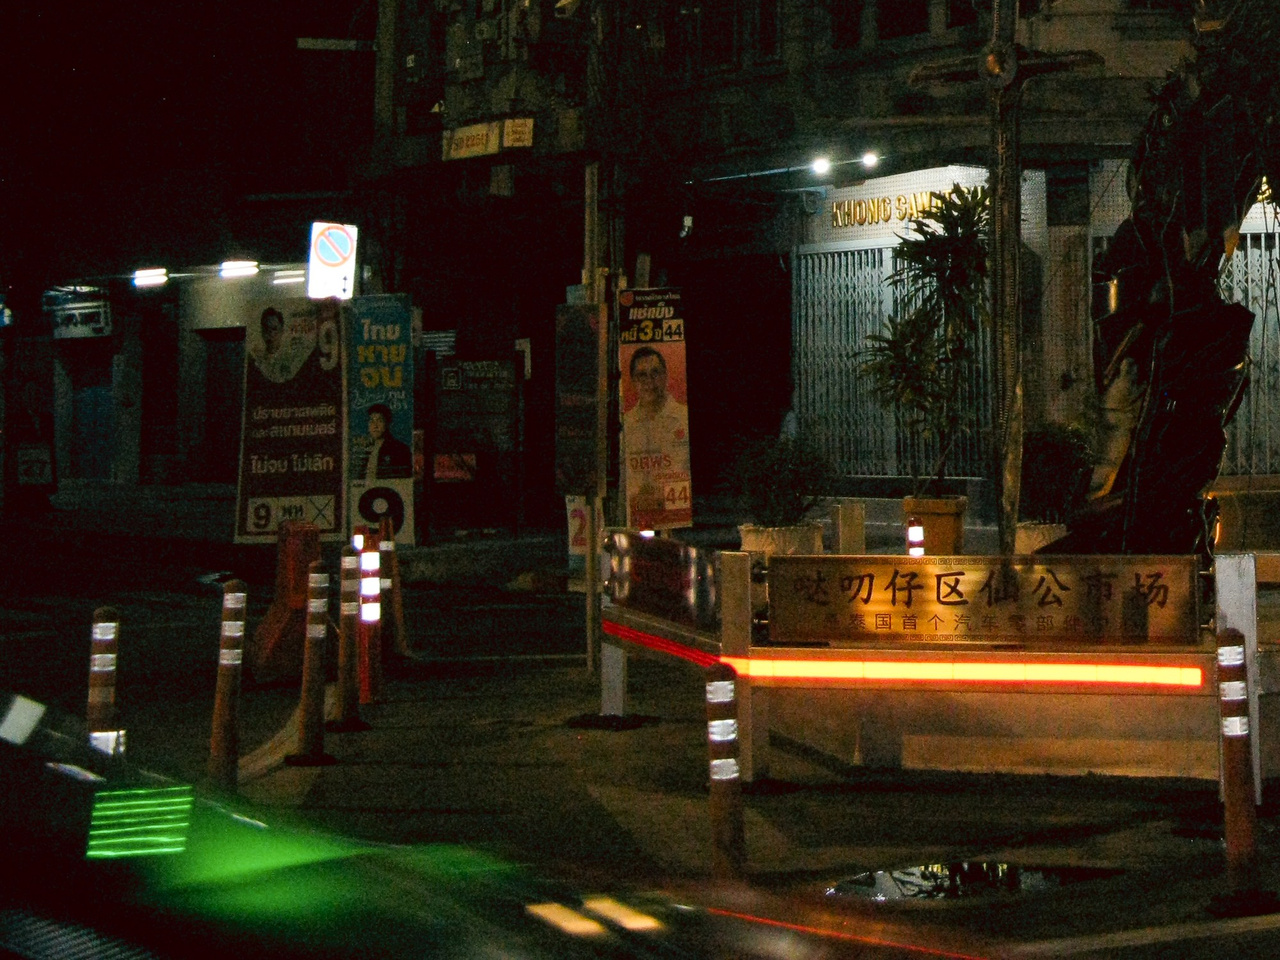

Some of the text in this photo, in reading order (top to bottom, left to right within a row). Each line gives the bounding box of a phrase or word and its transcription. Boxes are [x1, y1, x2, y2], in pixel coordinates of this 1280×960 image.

[831, 196, 892, 228] KHONG
[360, 319, 401, 341] ไทย
[639, 321, 654, 341] 3
[665, 324, 682, 339] 44
[319, 320, 339, 371] 9
[358, 344, 407, 364] หาย
[665, 486, 689, 505] 44
[253, 501, 272, 530] 9
